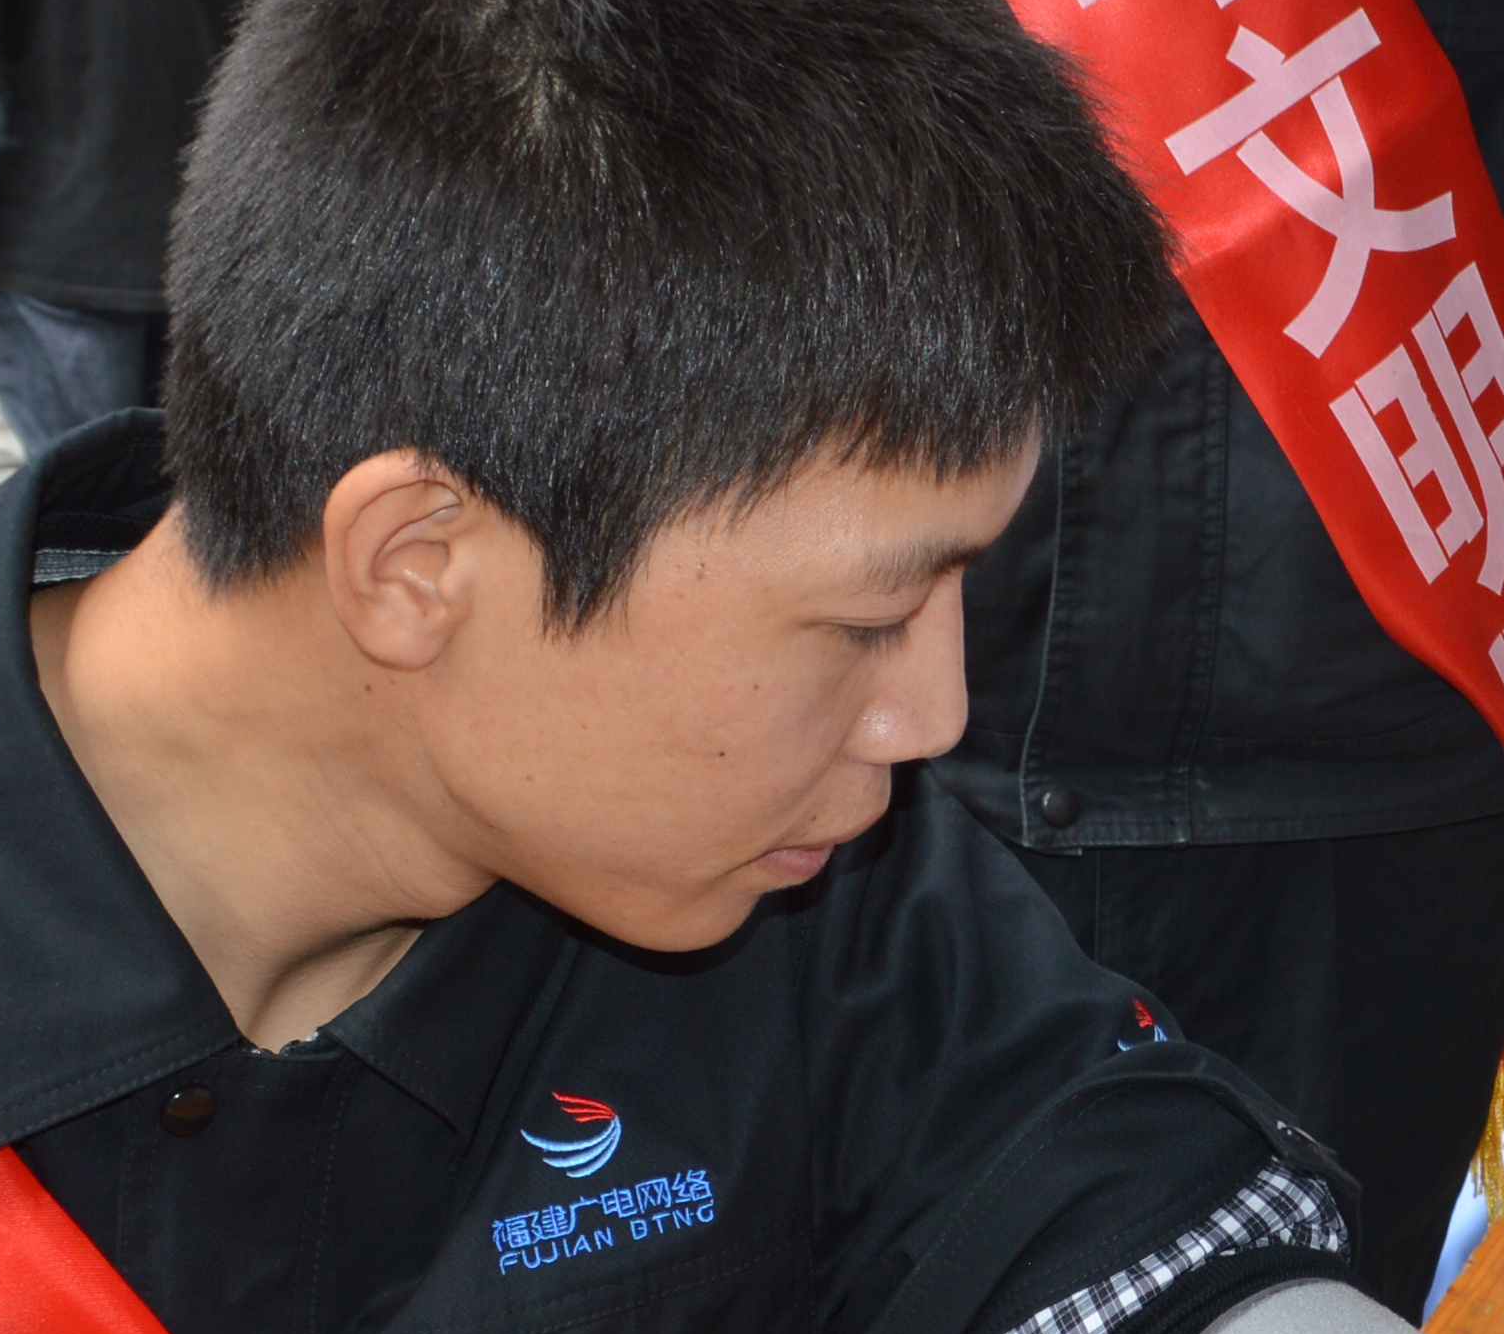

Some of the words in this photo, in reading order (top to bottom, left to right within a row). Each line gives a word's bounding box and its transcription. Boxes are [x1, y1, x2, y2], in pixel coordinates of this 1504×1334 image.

[492, 1169, 713, 1252] 福建广电网络
[499, 1227, 614, 1276] FUJIAN
[629, 1199, 715, 1241] BTNG
